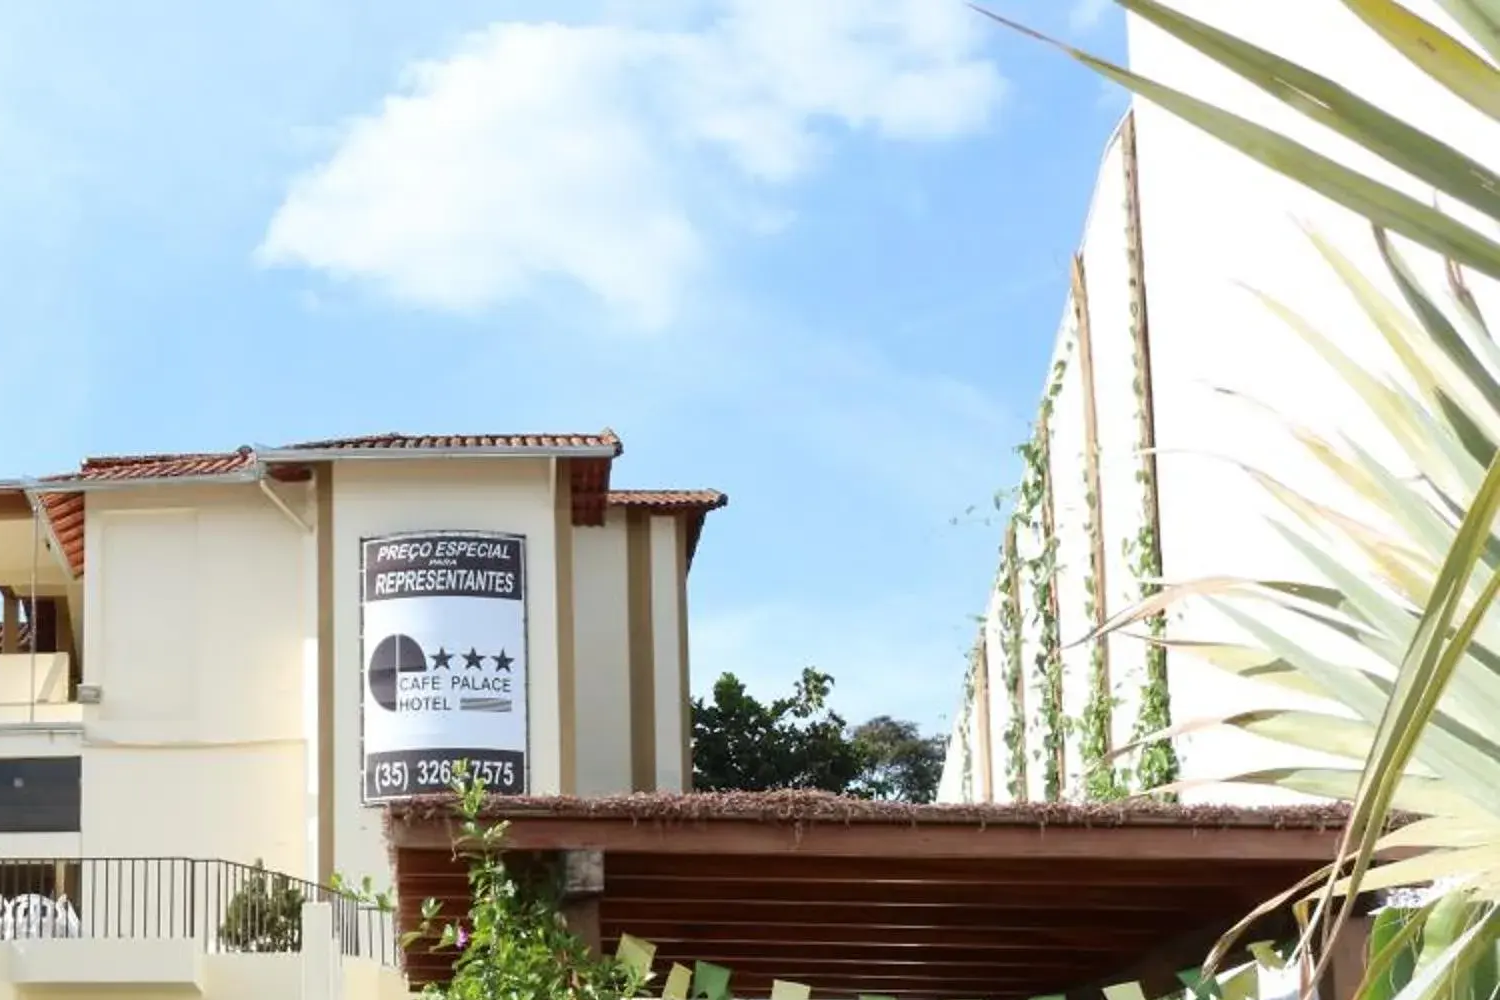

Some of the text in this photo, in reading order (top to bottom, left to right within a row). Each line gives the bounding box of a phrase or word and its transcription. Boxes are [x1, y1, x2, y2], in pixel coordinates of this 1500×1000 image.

[377, 541, 511, 562] PREÇO ESPECIAL
[375, 569, 514, 595] REPRESENTANTES
[451, 676, 512, 693] PALACE
[399, 697, 452, 711] HOTEL
[375, 761, 409, 794] (35)
